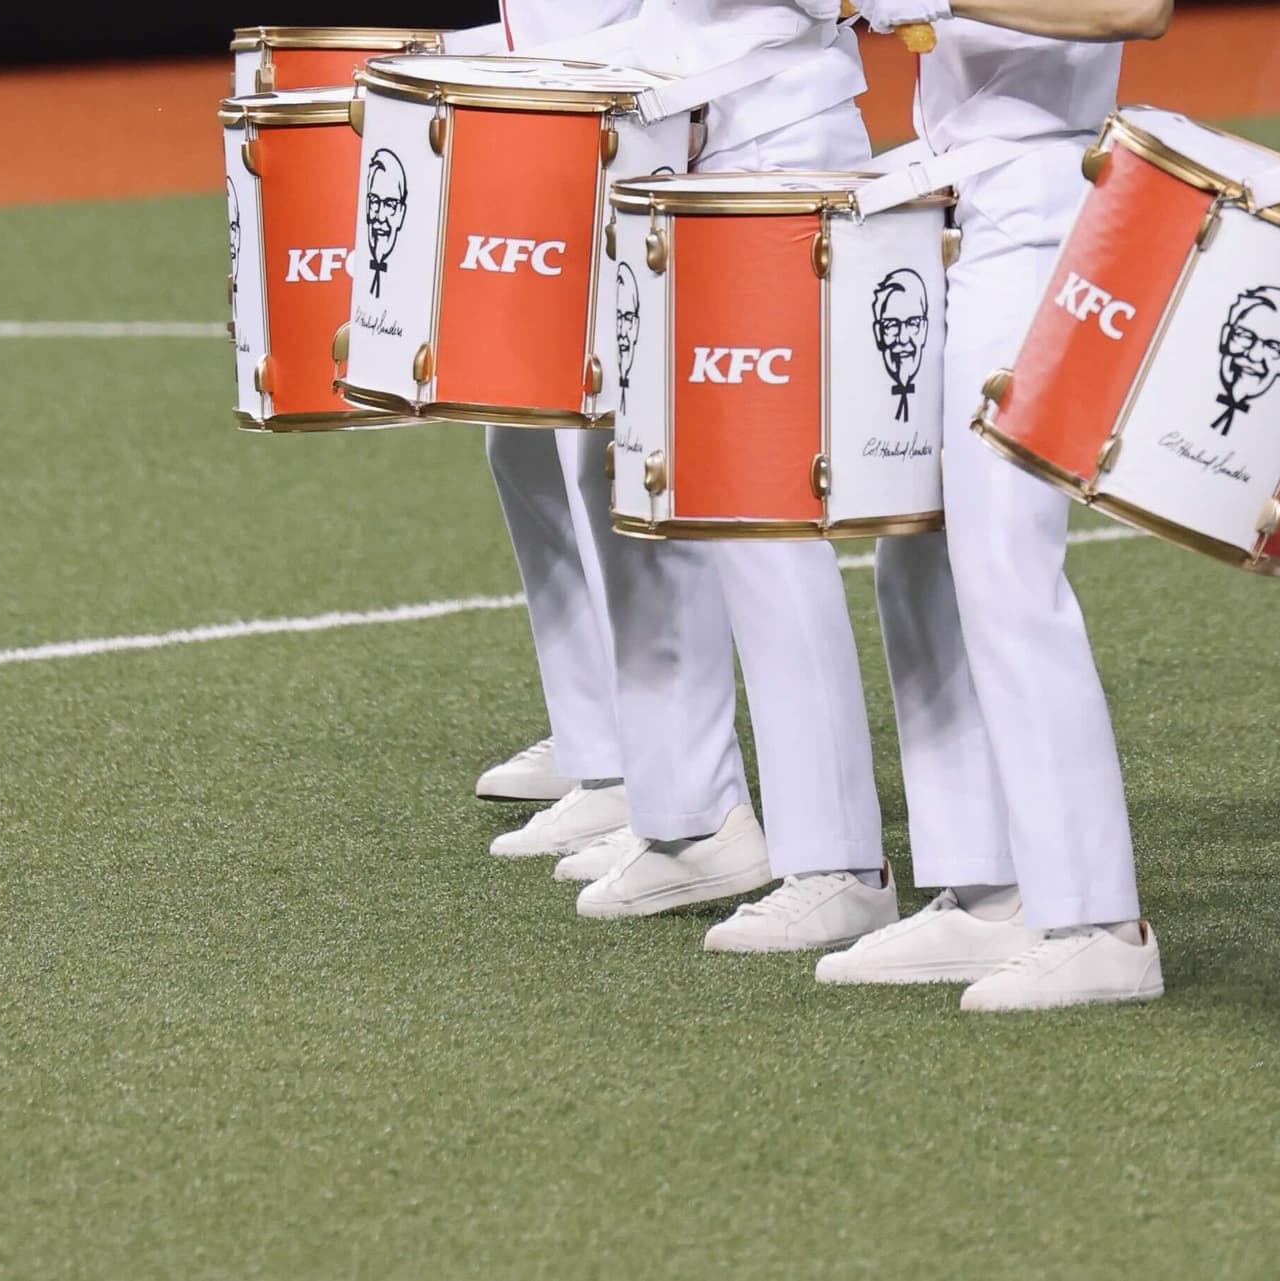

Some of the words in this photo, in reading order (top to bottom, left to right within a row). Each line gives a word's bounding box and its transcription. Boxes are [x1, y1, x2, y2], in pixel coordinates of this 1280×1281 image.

[459, 235, 567, 276] KFC
[1055, 271, 1136, 340] KFC
[688, 346, 793, 385] KFC
